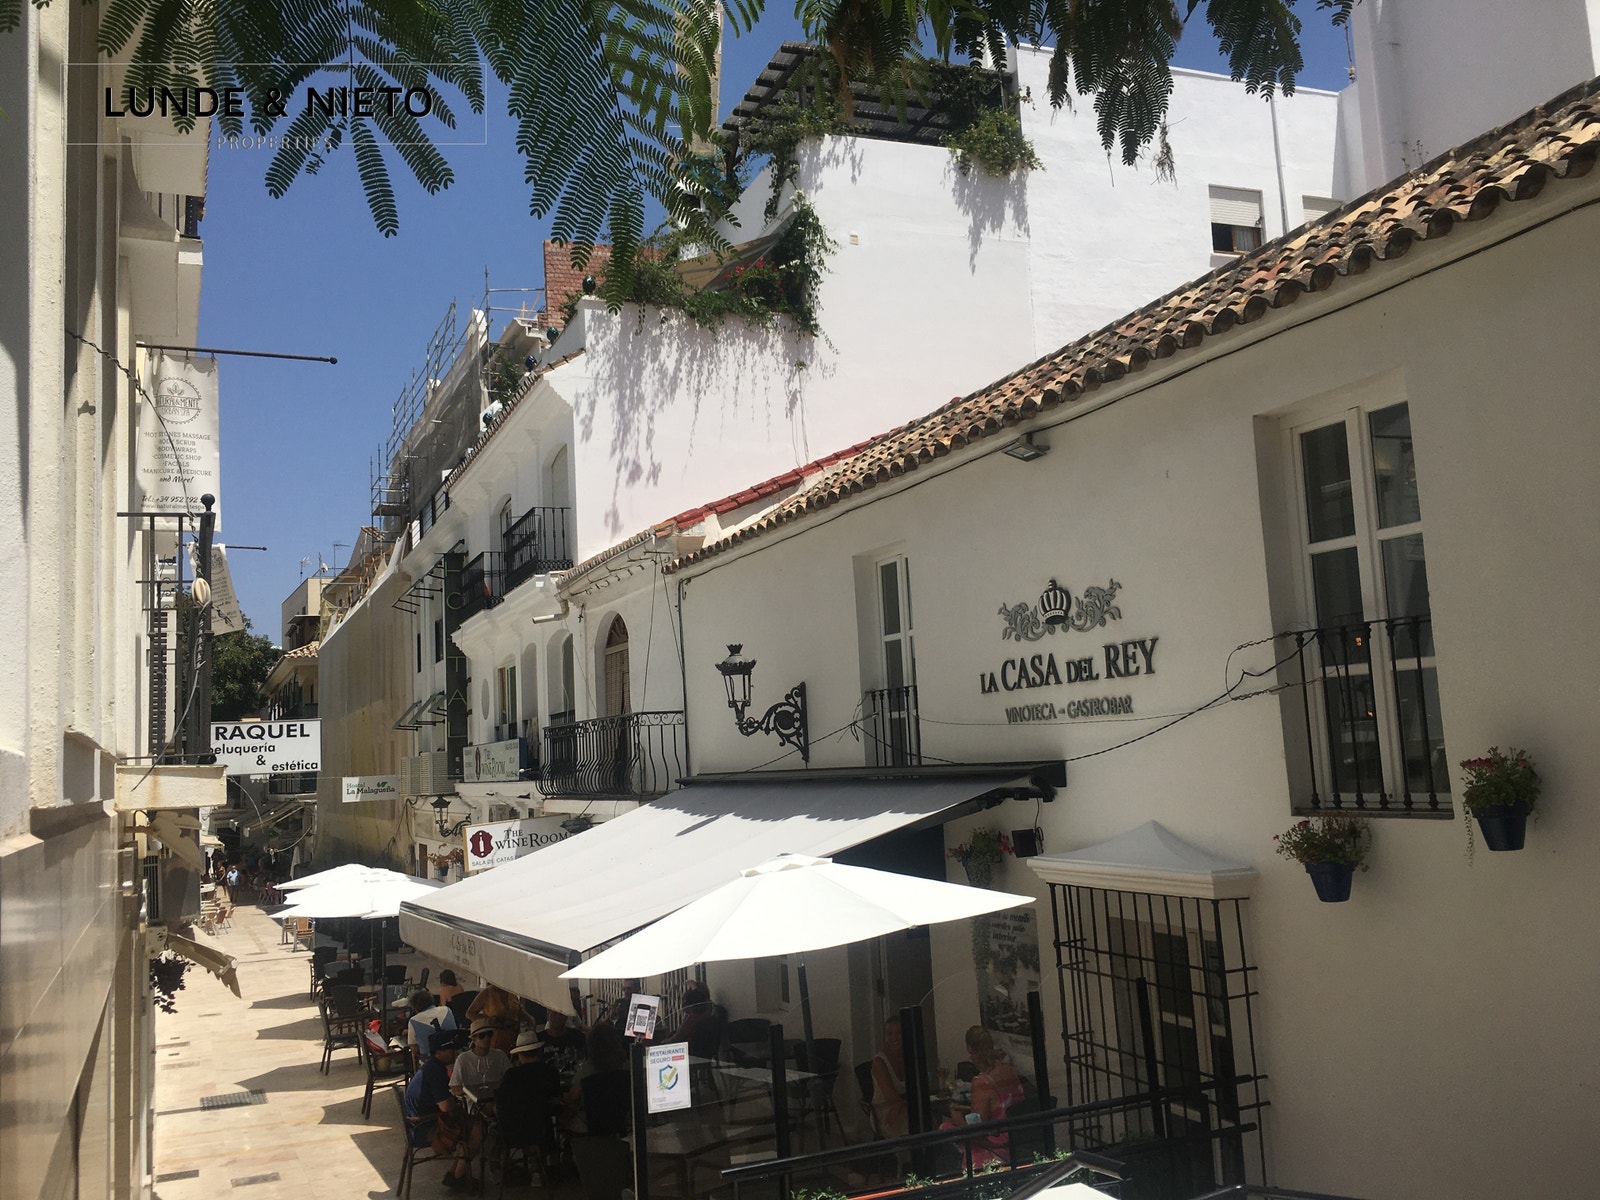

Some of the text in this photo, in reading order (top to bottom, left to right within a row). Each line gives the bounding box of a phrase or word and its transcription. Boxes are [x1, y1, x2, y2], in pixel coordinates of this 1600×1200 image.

[182, 432, 211, 441] MASSAGE
[182, 468, 212, 476] PEDICURE
[446, 561, 468, 738] HOTAL
[979, 637, 1159, 694] LA CASA DEL REY
[1005, 703, 1057, 724] VINOTECA
[1067, 695, 1134, 720] GASTROBAR
[214, 723, 310, 741] RAQUEL
[256, 754, 266, 766] &
[271, 760, 318, 772] estética
[356, 786, 395, 795] Malagueña
[504, 829, 523, 840] THE
[649, 1047, 685, 1058] RESTAURANTE
[650, 1056, 671, 1065] SEGURO
